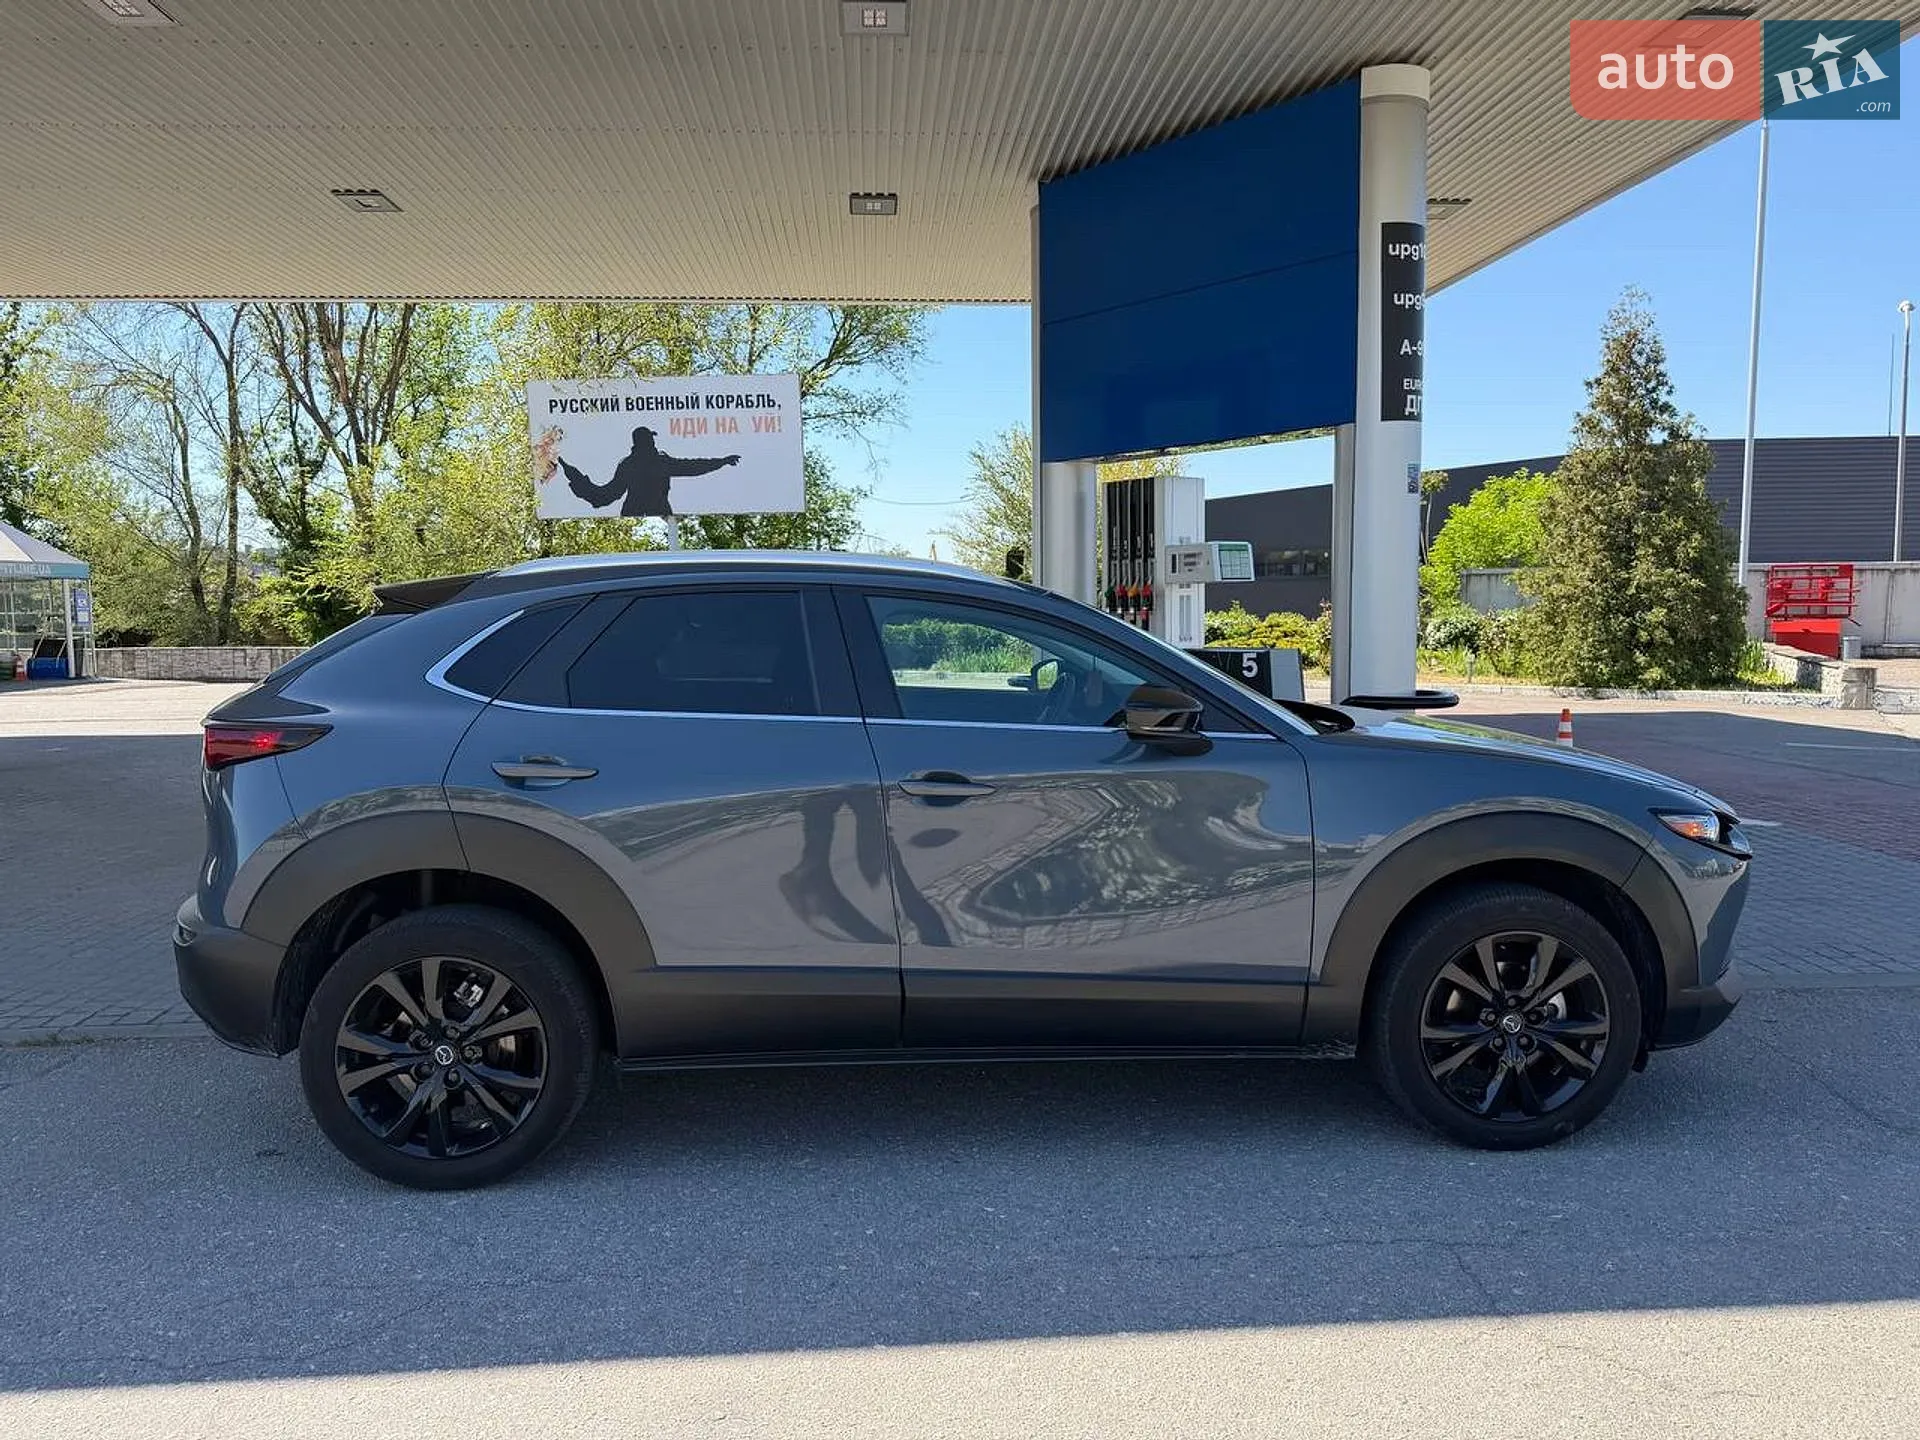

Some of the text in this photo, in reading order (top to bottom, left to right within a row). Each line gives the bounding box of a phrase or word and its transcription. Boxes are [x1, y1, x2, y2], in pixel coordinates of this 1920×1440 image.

[1403, 378, 1423, 390] EUR
[549, 392, 782, 414] РУССКИЙ ВОЕННЫЙ КОРАБЛЬ,
[669, 416, 708, 438] ИДИ
[715, 416, 739, 433] НА
[1242, 652, 1259, 678] 5
